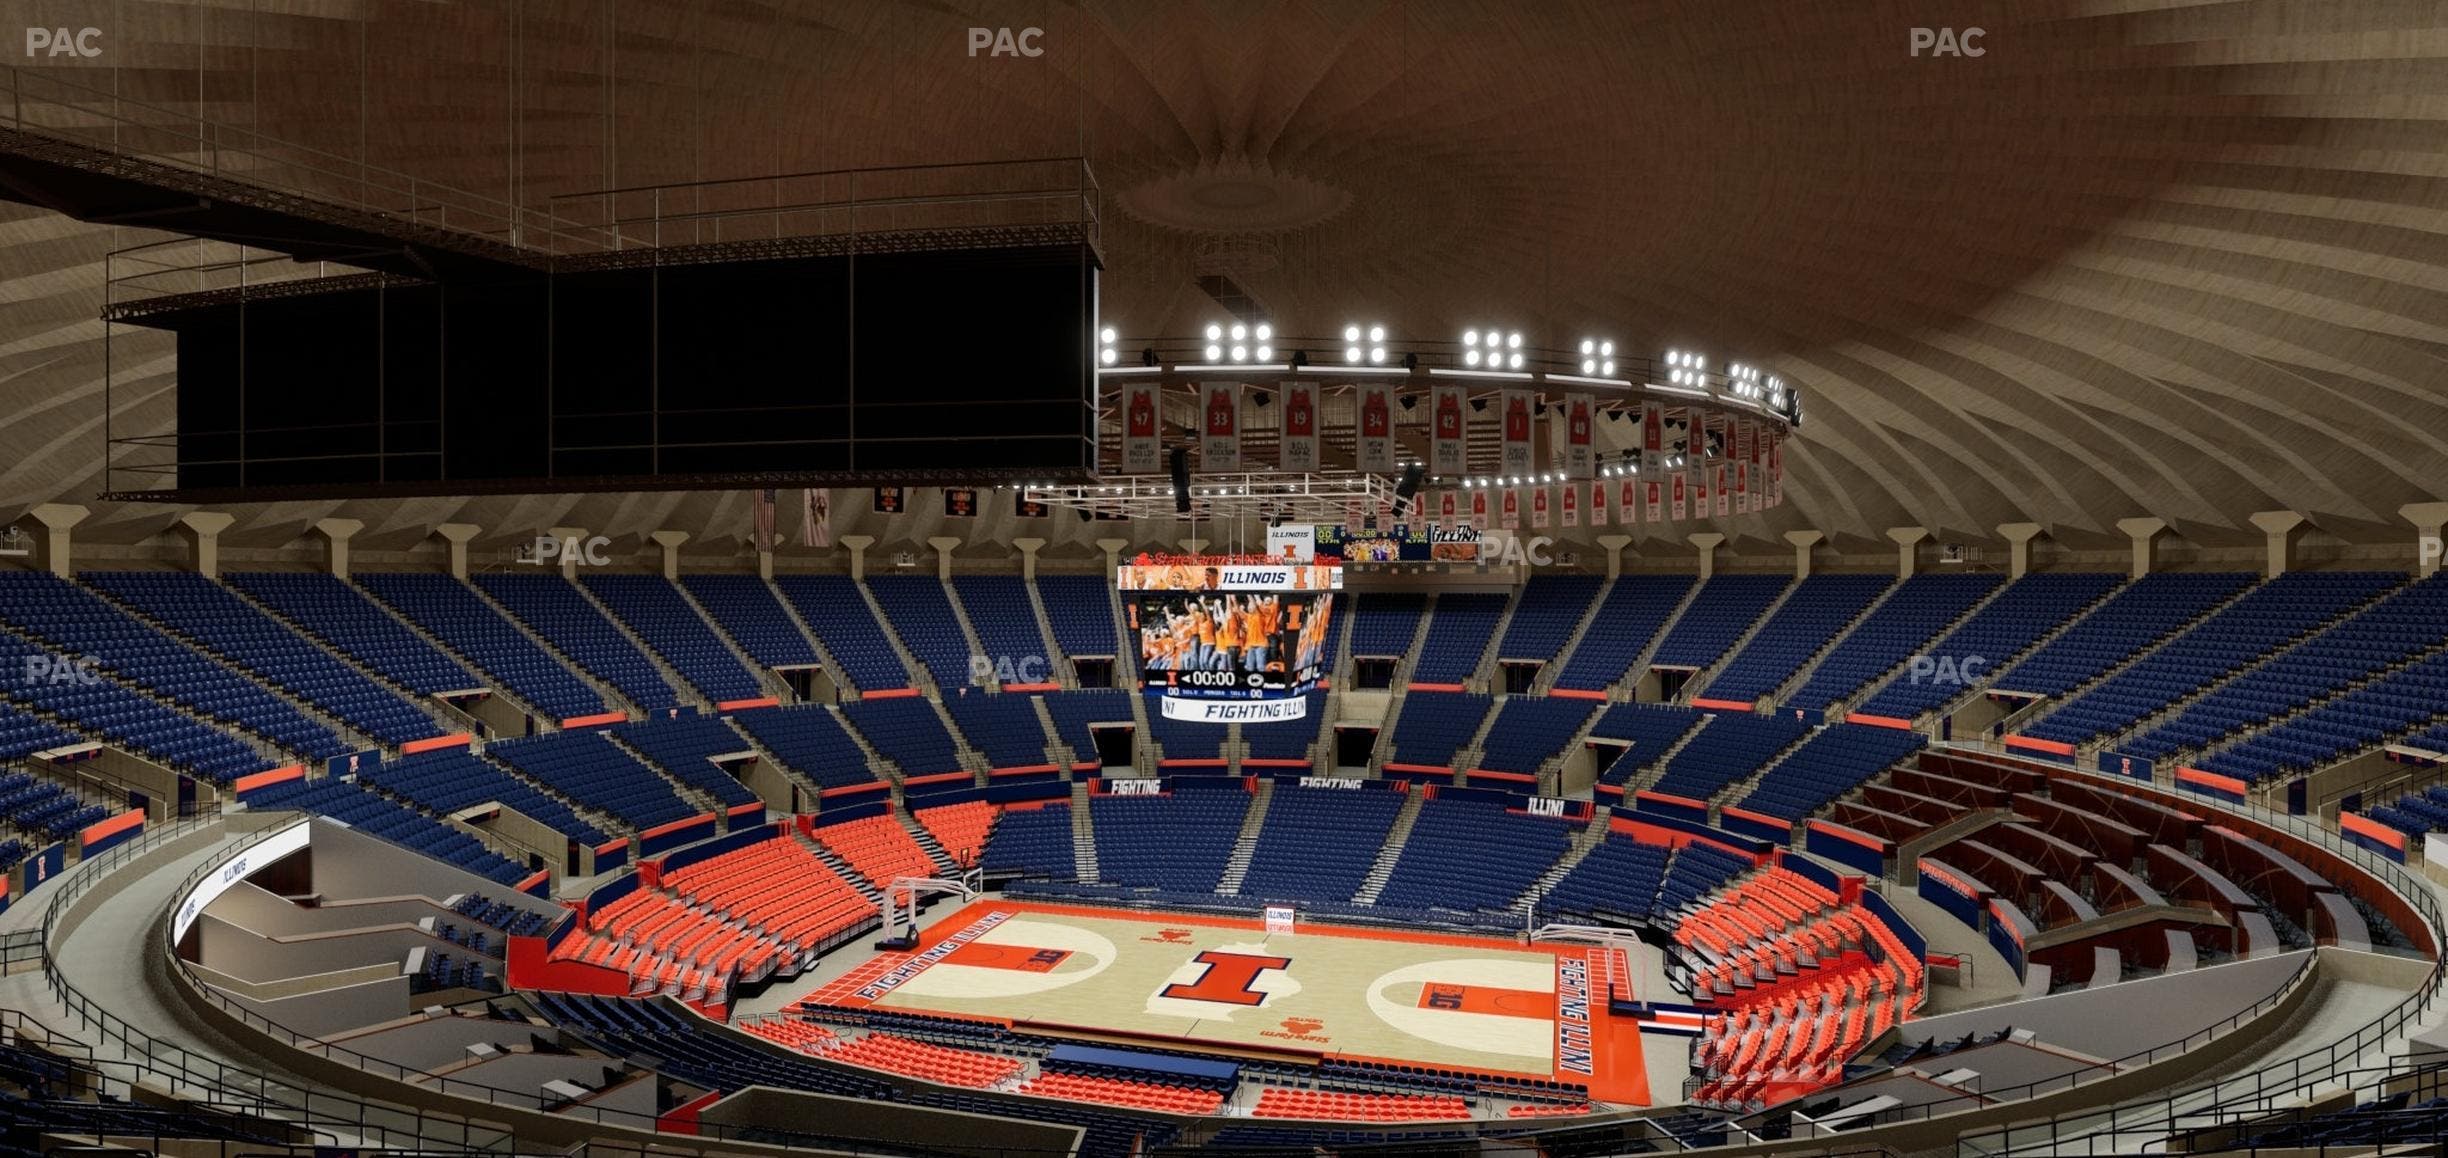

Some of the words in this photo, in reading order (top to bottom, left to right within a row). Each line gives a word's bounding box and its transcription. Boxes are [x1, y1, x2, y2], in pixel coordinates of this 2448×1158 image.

[1135, 412, 1148, 426] 47
[1214, 412, 1228, 426] 33
[1294, 412, 1306, 425] 19
[1369, 414, 1382, 428] 34
[1222, 572, 1286, 584] ILLINOIS
[1192, 671, 1236, 686] 00:00
[1168, 687, 1180, 696] 00
[1250, 689, 1263, 698] 00
[1205, 704, 1280, 718] FIGHTING
[1111, 779, 1161, 795] FIGHTING
[1300, 776, 1363, 790] FIGHTING
[1528, 797, 1565, 817] ILLINI
[223, 858, 247, 884] ILLINOIS
[1268, 910, 1292, 920] ILLINOIS
[855, 941, 959, 1000] FIGHTING
[954, 911, 1008, 942] ILLINI
[1160, 950, 1293, 1006] I
[1560, 956, 1590, 1022] FIGHTING
[1560, 1021, 1594, 1076] ILLINI
